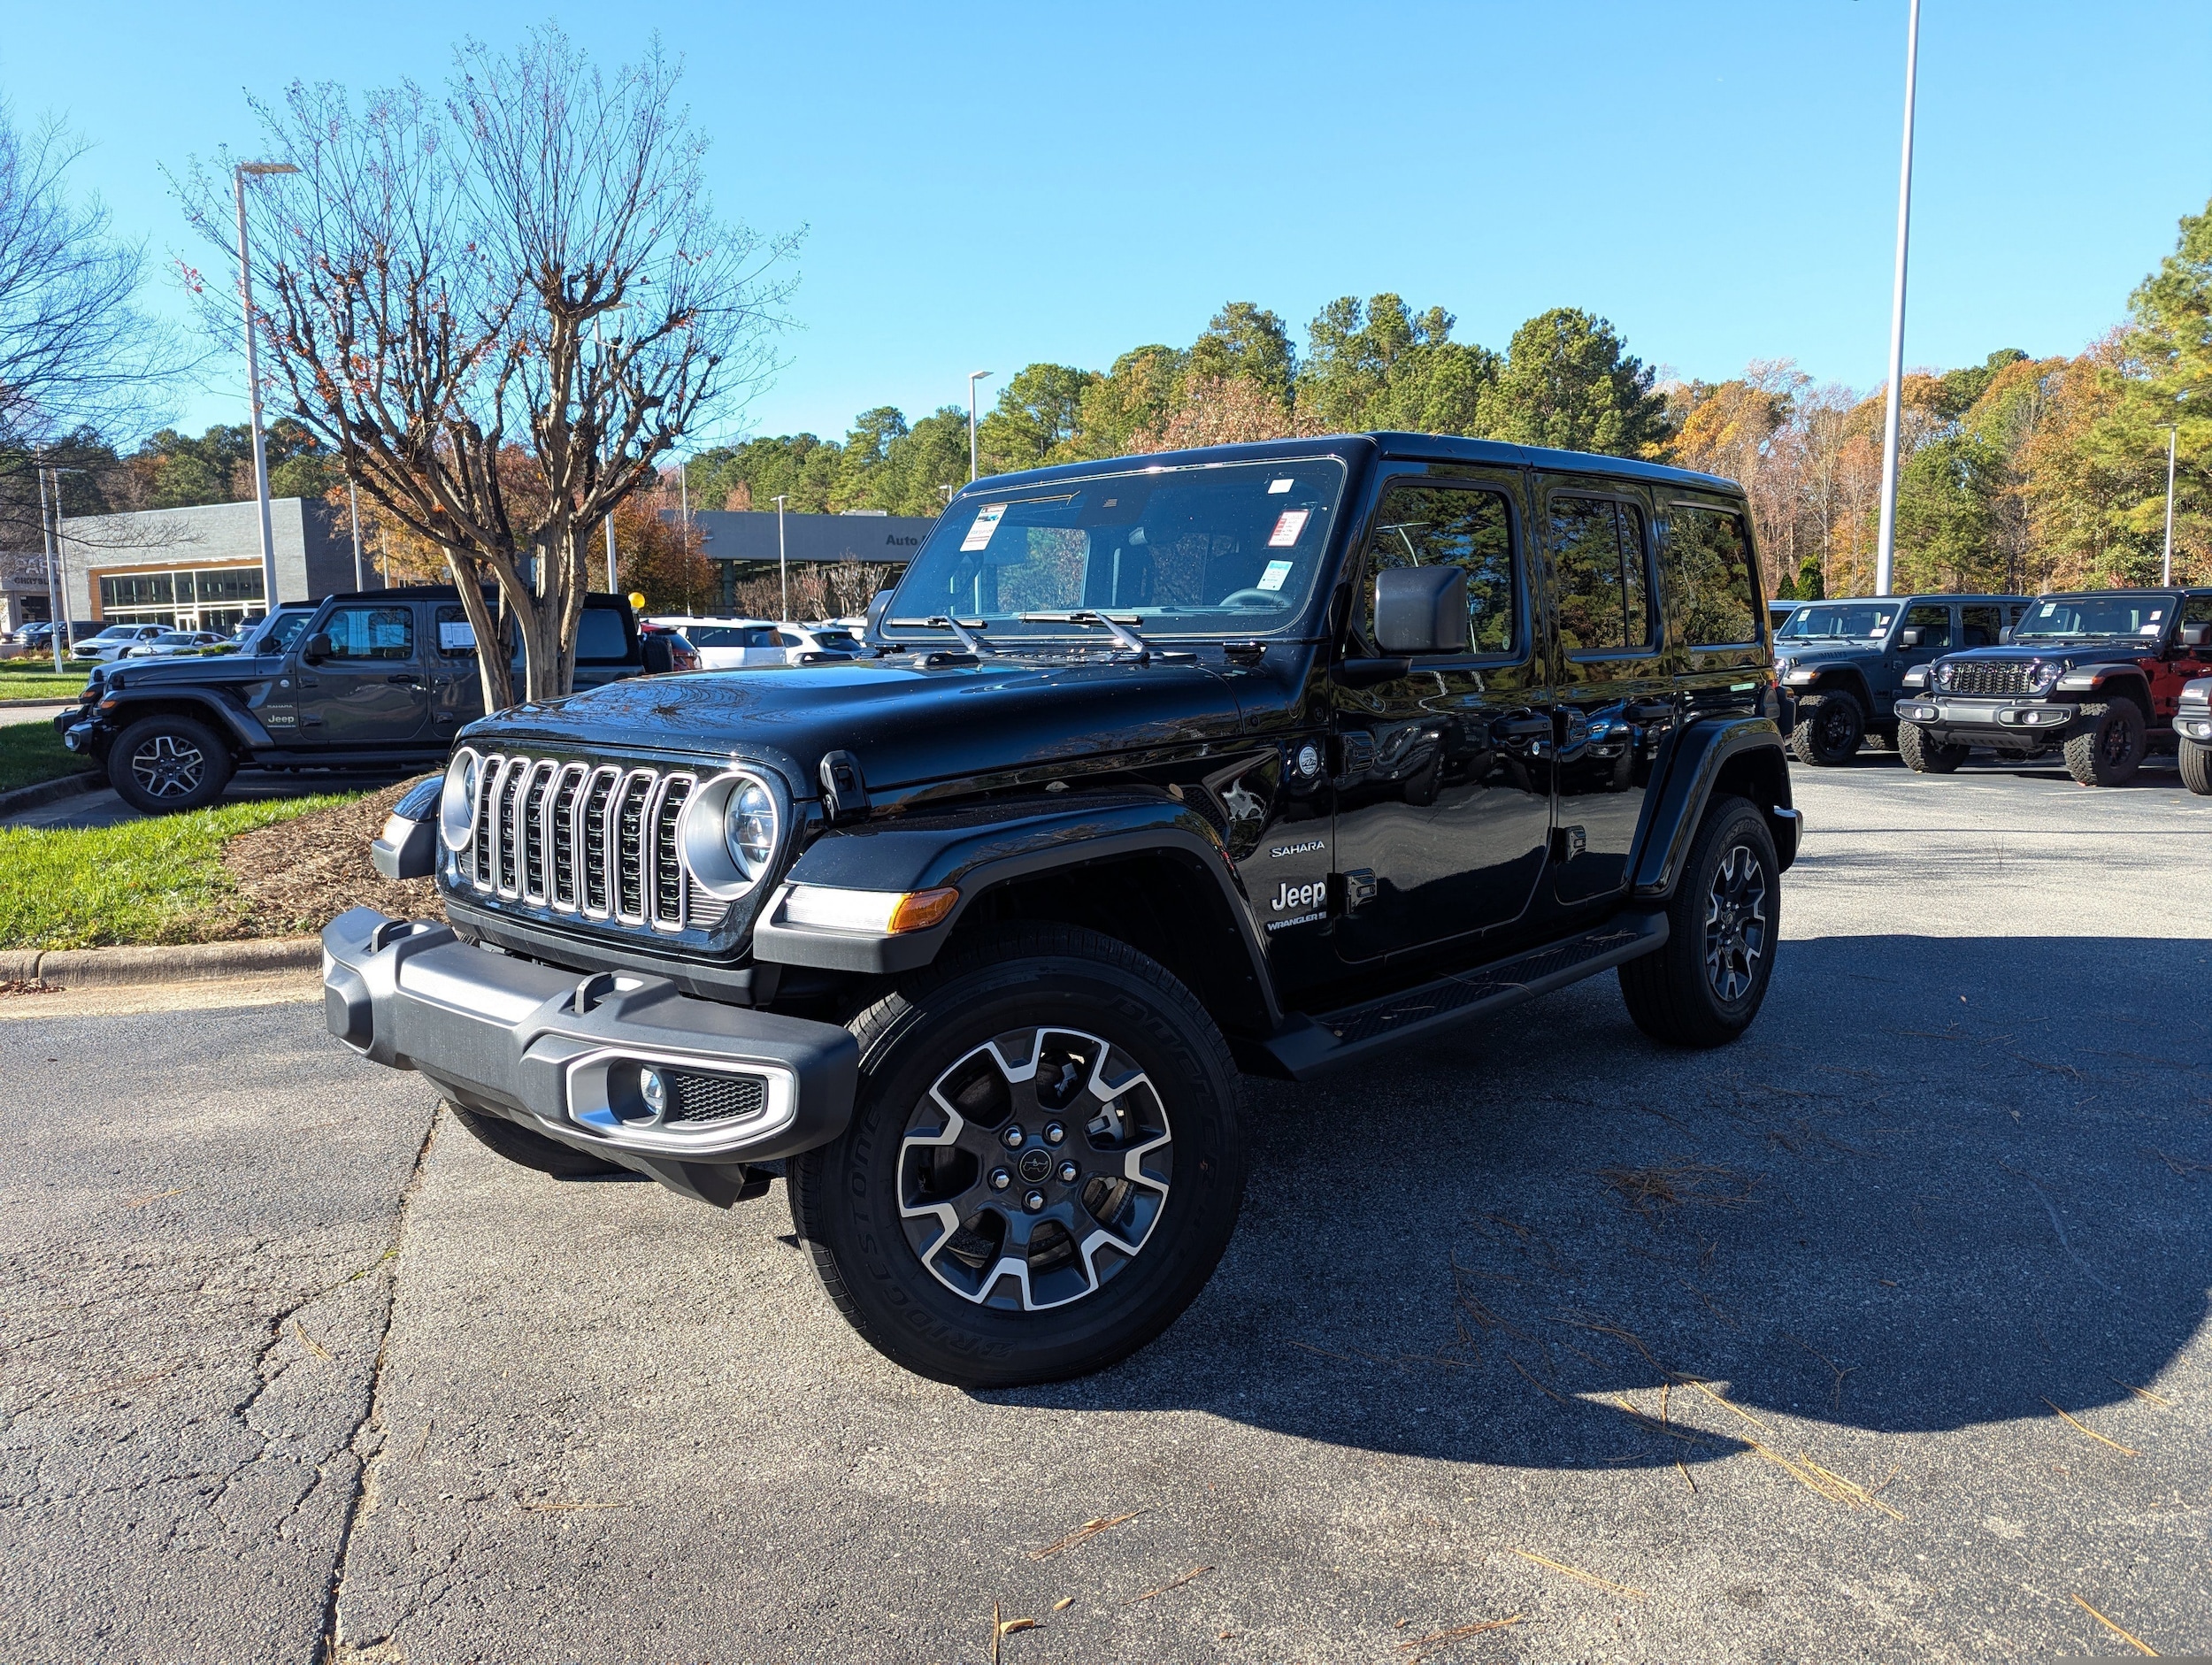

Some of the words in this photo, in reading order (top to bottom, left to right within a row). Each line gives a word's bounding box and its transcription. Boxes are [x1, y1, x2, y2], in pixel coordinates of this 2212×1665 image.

[886, 534, 918, 546] Auto
[267, 714, 295, 724] Jeep
[1271, 840, 1325, 858] SAHARA
[1271, 881, 1326, 911] Jeep
[1267, 913, 1318, 932] WRANGLER
[1108, 994, 1220, 1189] DUELER
[849, 1104, 1017, 1360] BRIDGESTONE
